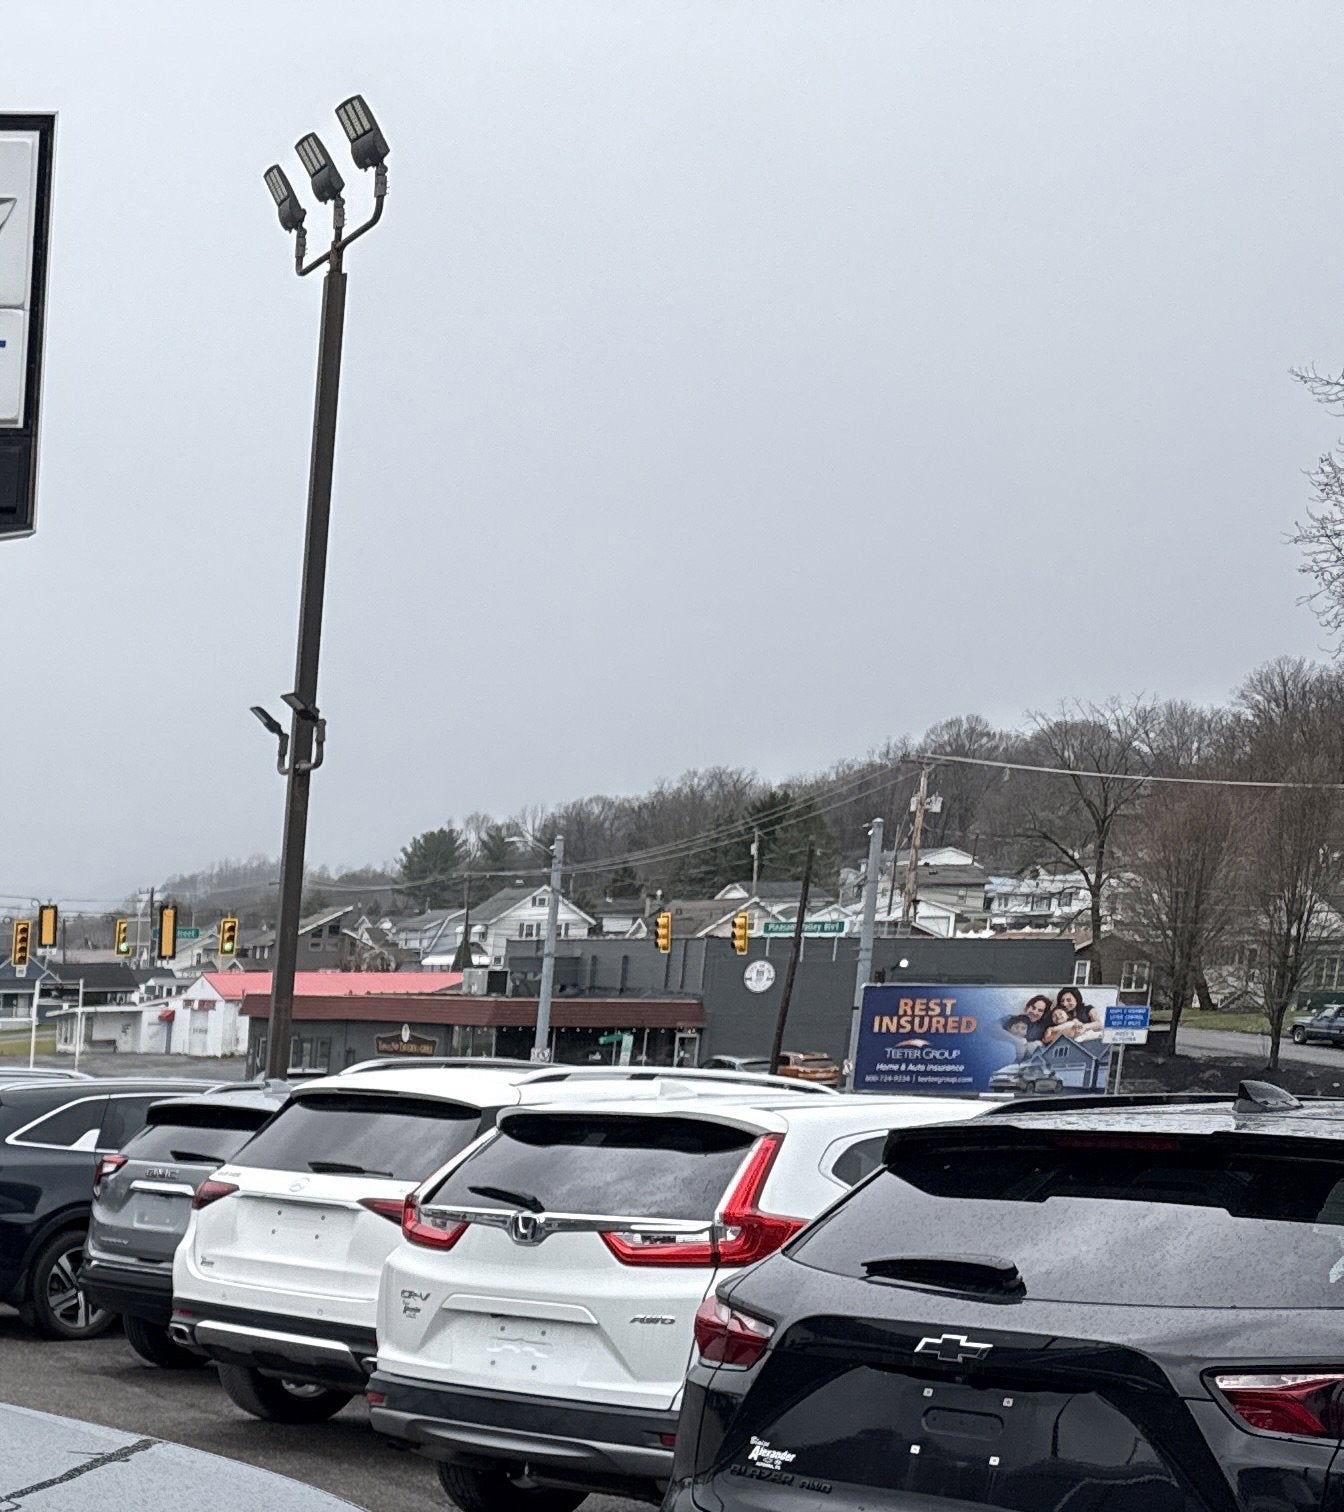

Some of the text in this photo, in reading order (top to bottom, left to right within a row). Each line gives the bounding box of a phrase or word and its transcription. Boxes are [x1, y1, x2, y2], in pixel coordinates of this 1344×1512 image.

[898, 998, 957, 1015] REST
[873, 1015, 977, 1033] INSURED
[885, 1047, 961, 1060] TEETER GROUP
[876, 1063, 899, 1071] Home
[907, 1063, 925, 1071] Auto
[748, 1445, 797, 1462] Alexander
[730, 1464, 794, 1487] BLAZER
